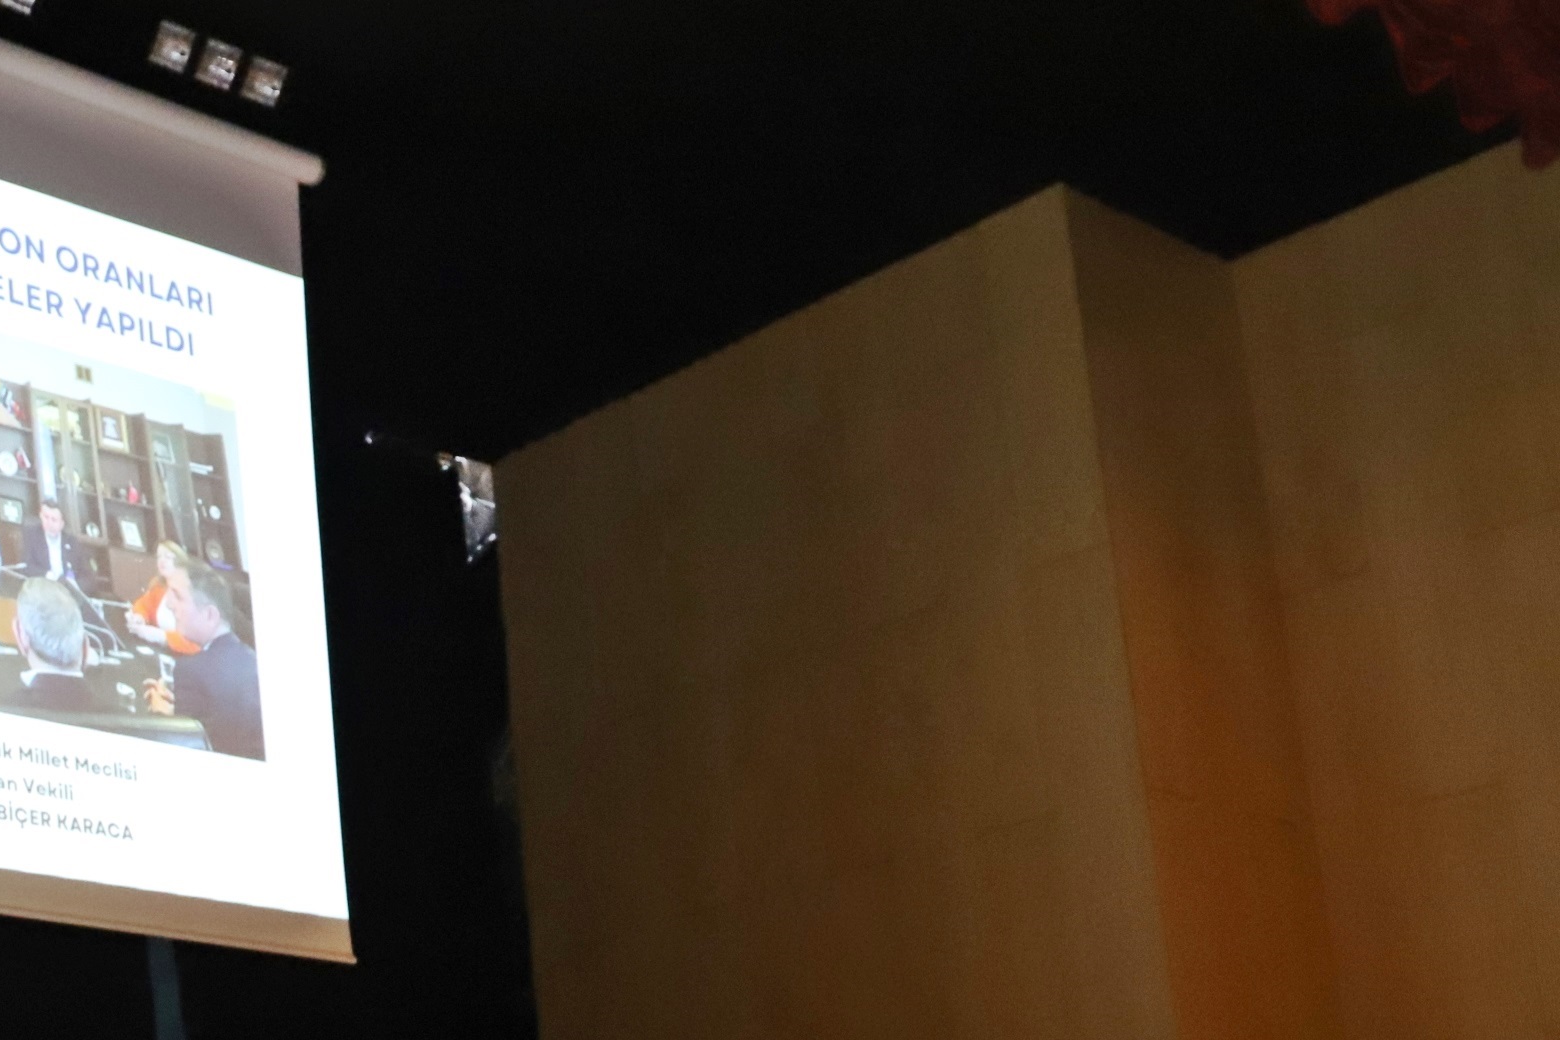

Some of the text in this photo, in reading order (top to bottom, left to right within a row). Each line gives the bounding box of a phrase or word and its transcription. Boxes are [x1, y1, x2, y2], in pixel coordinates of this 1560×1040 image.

[55, 246, 214, 316] ORANLARI
[73, 296, 195, 356] YAPILDI
[19, 746, 69, 769] Millet
[75, 757, 138, 782] Meclisi
[23, 777, 74, 801] Vekili
[57, 814, 134, 840] KARACA
